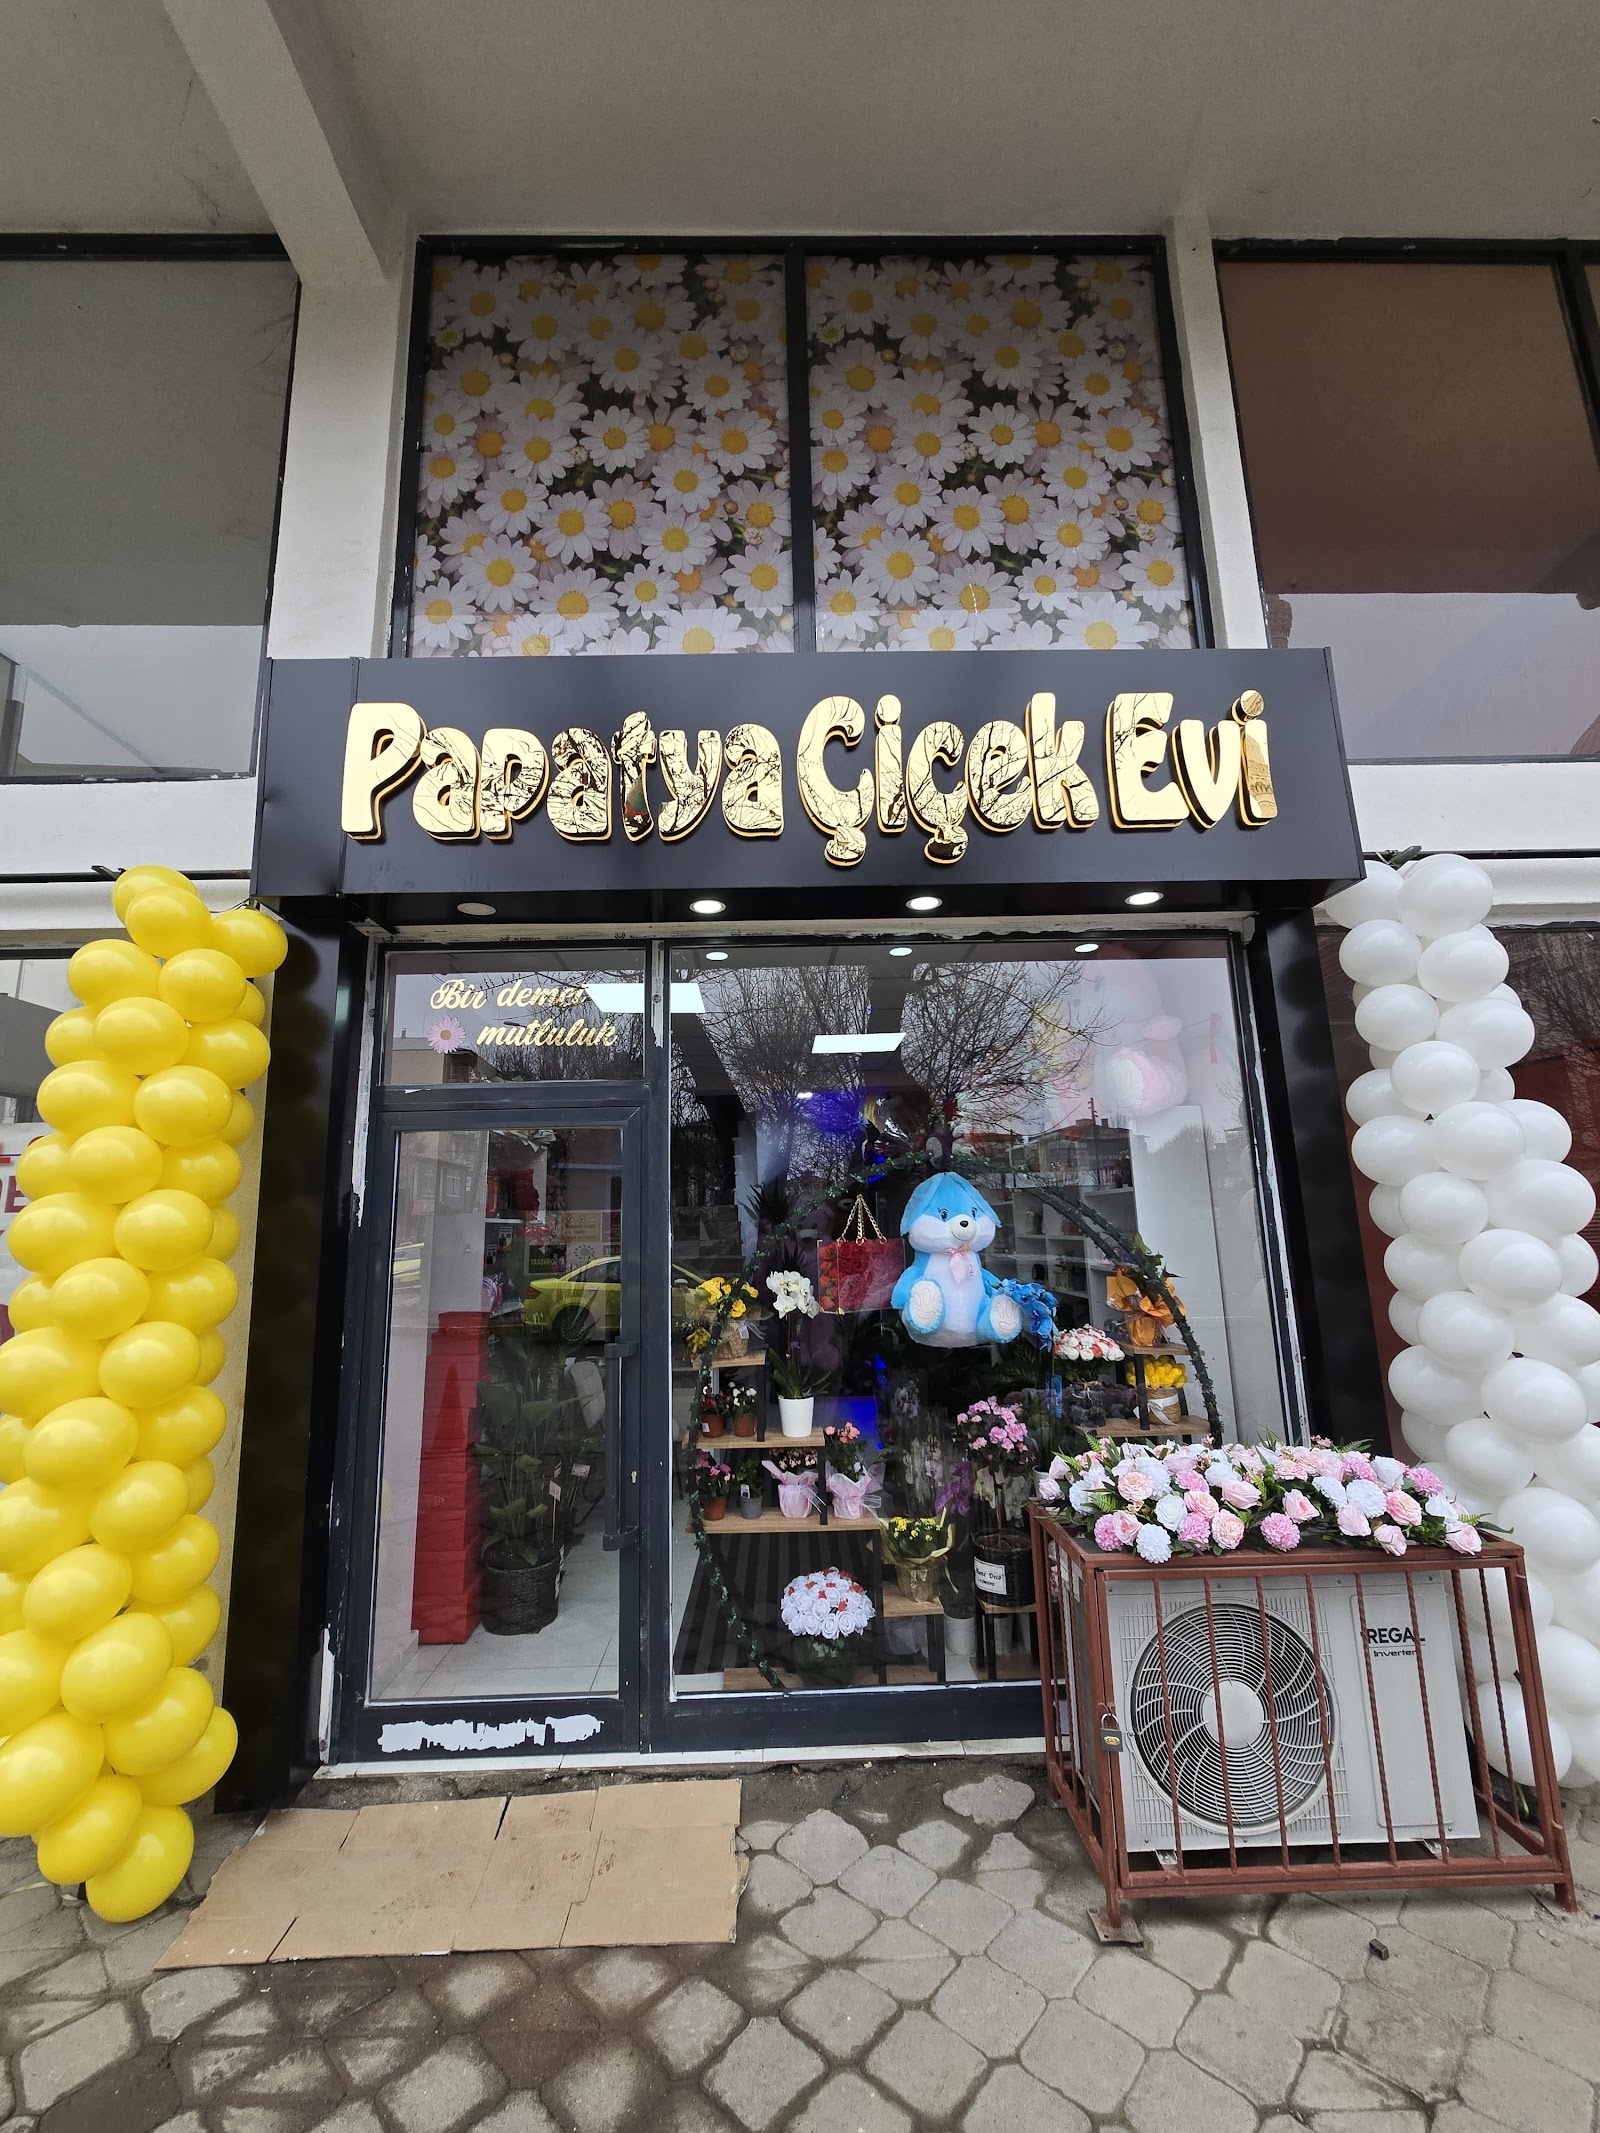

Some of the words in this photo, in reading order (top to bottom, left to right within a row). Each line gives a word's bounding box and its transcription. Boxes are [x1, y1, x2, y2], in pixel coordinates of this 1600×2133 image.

[341, 702, 784, 842] Papatya
[796, 692, 1101, 866] Çiçek
[1106, 689, 1279, 830] Evi
[430, 979, 488, 1009] Bir
[476, 1018, 618, 1047] mutluluk
[1373, 1649, 1417, 1657] Inverter
